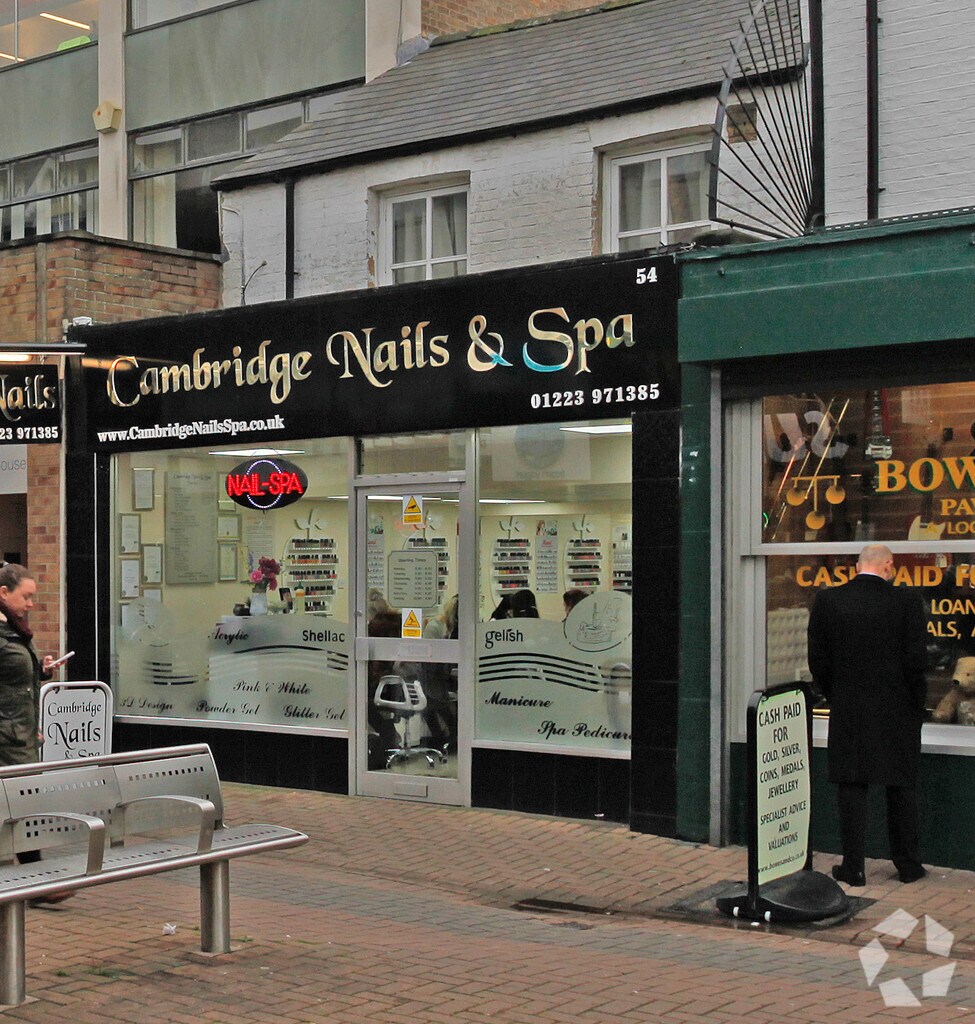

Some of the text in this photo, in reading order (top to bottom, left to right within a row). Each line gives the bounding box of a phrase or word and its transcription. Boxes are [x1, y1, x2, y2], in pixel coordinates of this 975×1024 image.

[636, 266, 658, 285] 54
[106, 307, 637, 407] Cambridge Nails & Spa
[530, 383, 661, 410] 01223 971385
[16, 426, 59, 440] 971385
[97, 414, 285, 443] www.CambridgeNailsSpa.co.uk
[226, 472, 305, 496] NAIL-SPA
[890, 565, 943, 588] AID
[956, 565, 975, 588] F
[207, 627, 346, 645] Acrylic Shellac
[484, 628, 524, 649] gelish
[926, 620, 962, 640] ALS,
[232, 679, 261, 693] Pink
[277, 680, 312, 695] White
[47, 701, 102, 717] Cambridge
[138, 696, 174, 713] Design
[196, 699, 237, 714] Powder
[240, 702, 261, 715] Gel
[283, 704, 321, 720] Glitter
[324, 706, 346, 721] Gel
[484, 691, 554, 708] Manicure
[758, 702, 801, 727] CASH PAID
[47, 720, 101, 750] Nails
[537, 720, 569, 740] Spa
[772, 726, 789, 744] FOR
[762, 742, 802, 764] GOLD, SILVER,
[759, 768, 780, 784] COINS,
[767, 778, 799, 799] JEWELLERY
[760, 800, 807, 826] SPECIALIST ADVICE
[778, 821, 790, 834] AND
[767, 831, 799, 851] VALUATIONS
